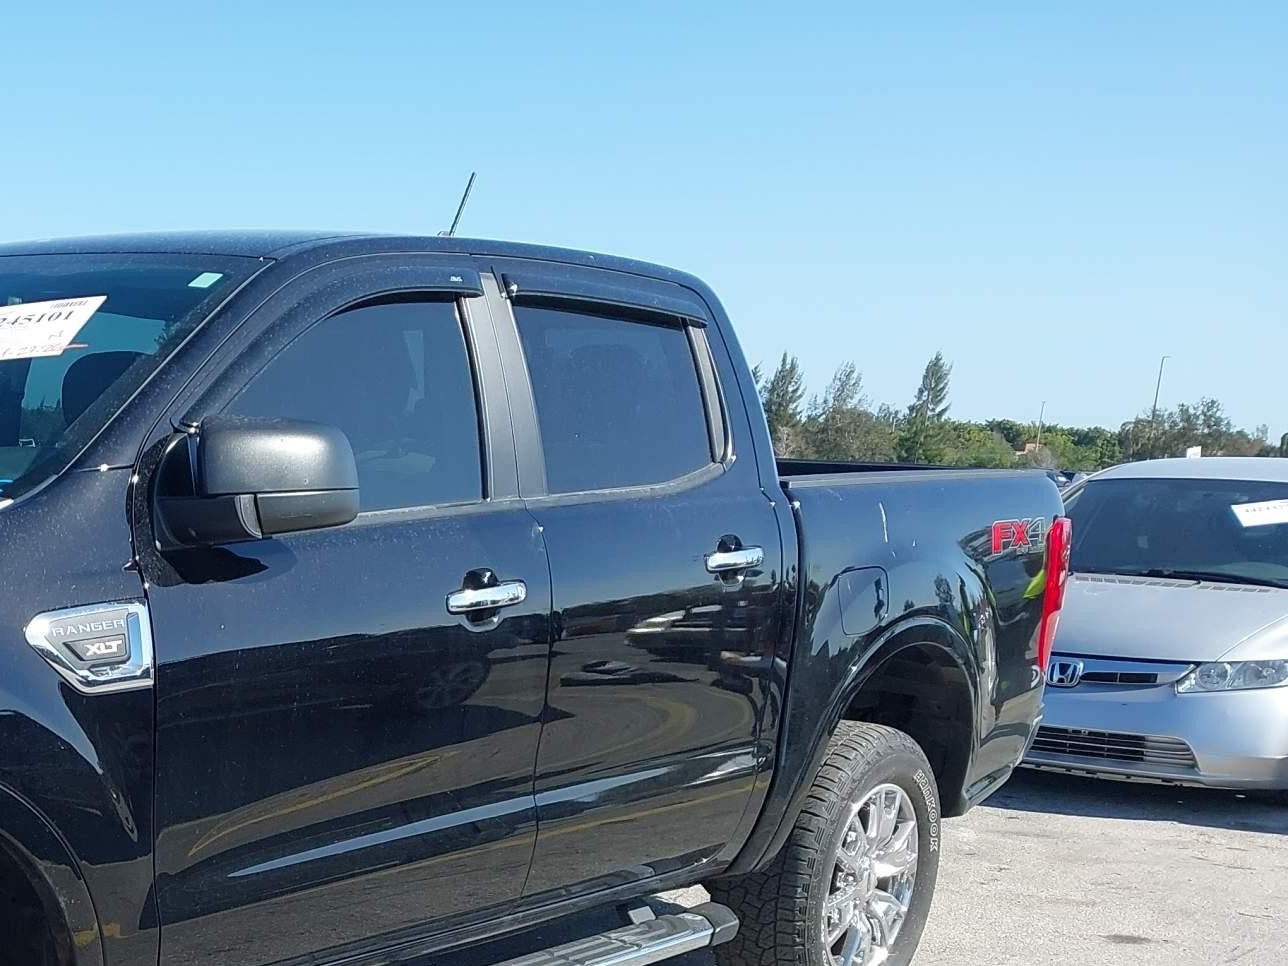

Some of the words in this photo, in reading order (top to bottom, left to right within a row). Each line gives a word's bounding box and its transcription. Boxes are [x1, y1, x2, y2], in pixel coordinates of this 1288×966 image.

[992, 517, 1046, 555] FX4
[51, 618, 125, 638] RANGER
[85, 639, 123, 656] XLT
